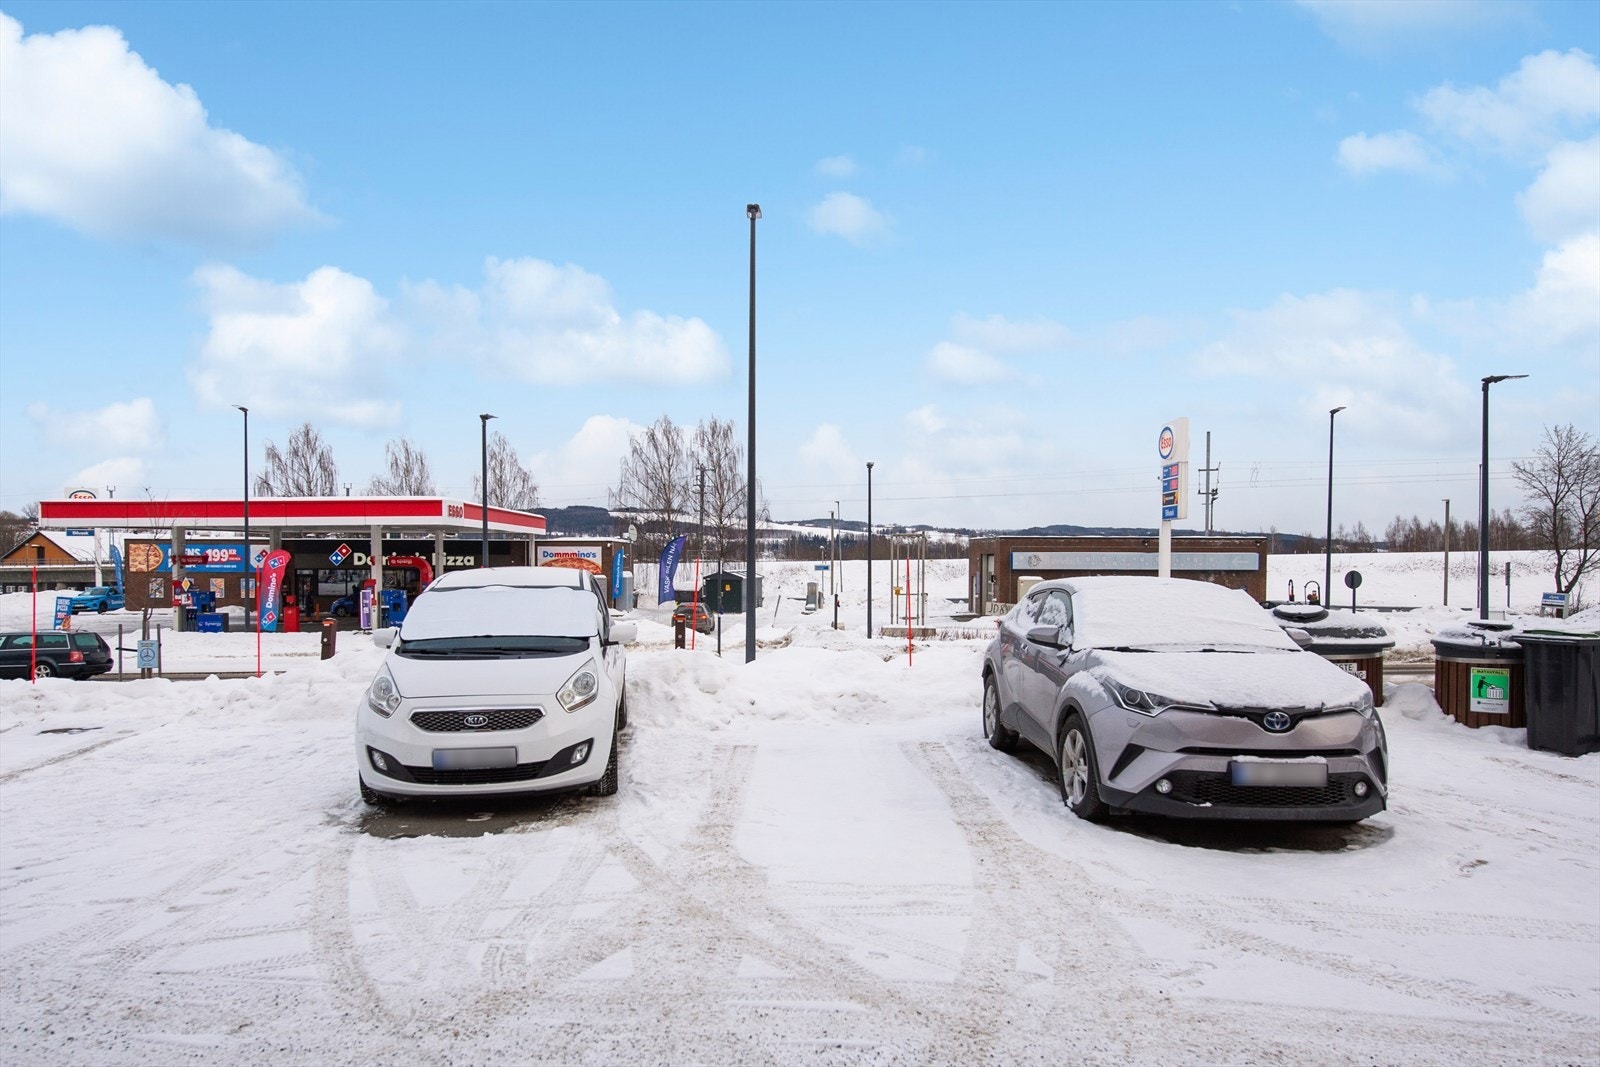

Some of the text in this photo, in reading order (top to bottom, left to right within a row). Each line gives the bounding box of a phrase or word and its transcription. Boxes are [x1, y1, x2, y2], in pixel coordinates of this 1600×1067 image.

[205, 548, 229, 562] 199
[542, 550, 597, 559] Dommmino's
[265, 572, 277, 609] Domino's
